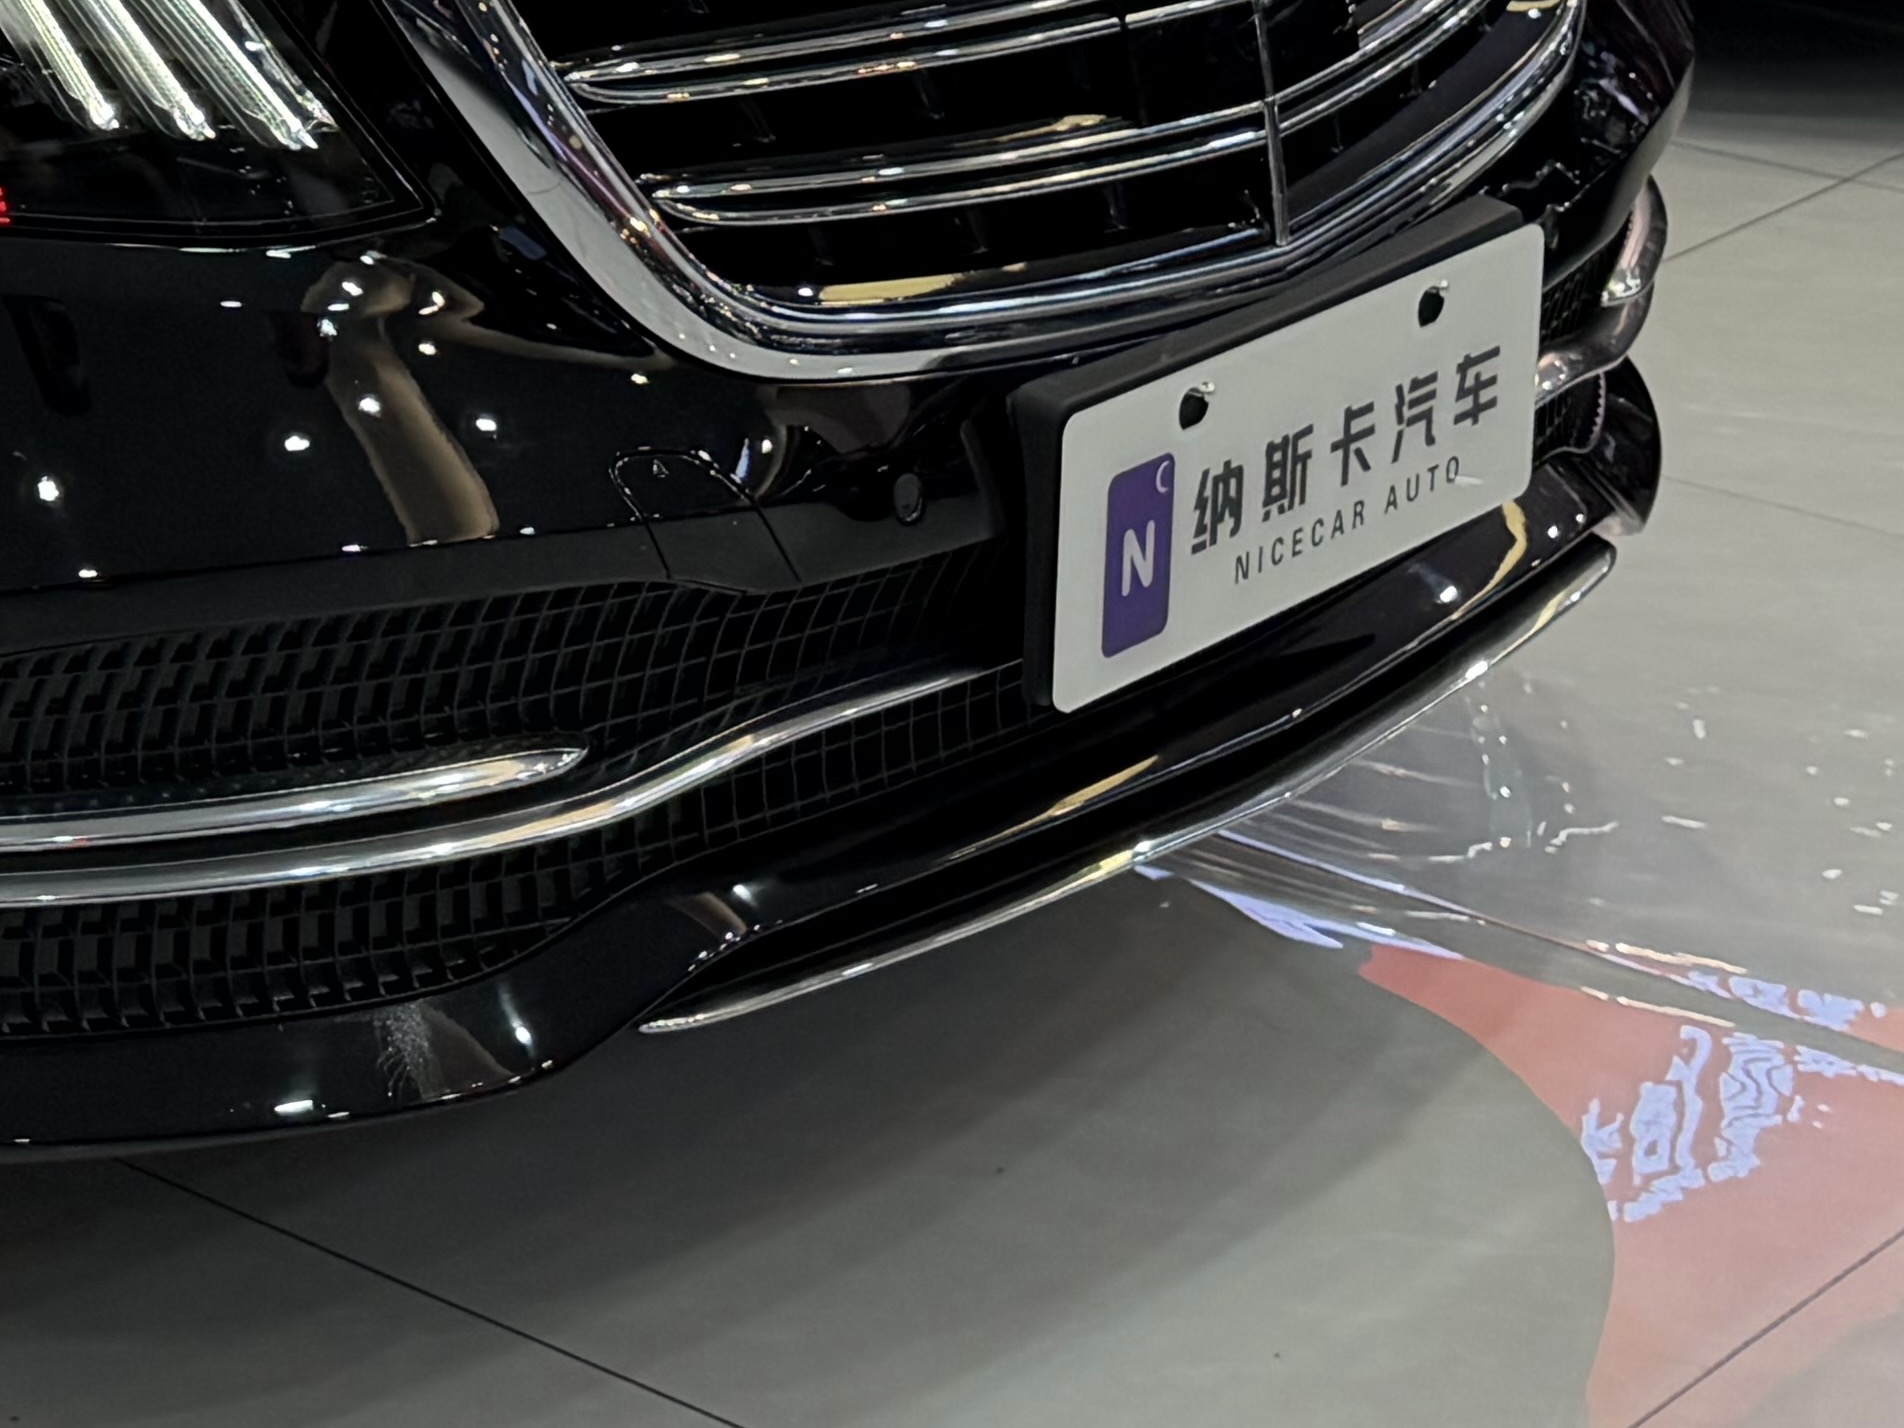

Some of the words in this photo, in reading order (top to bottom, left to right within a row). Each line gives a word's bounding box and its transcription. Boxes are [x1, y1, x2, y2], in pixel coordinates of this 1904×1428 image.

[1192, 346, 1501, 556] 纳斯卡汽车
[1233, 499, 1366, 585] NICECAR
[1383, 455, 1462, 510] AUTO
